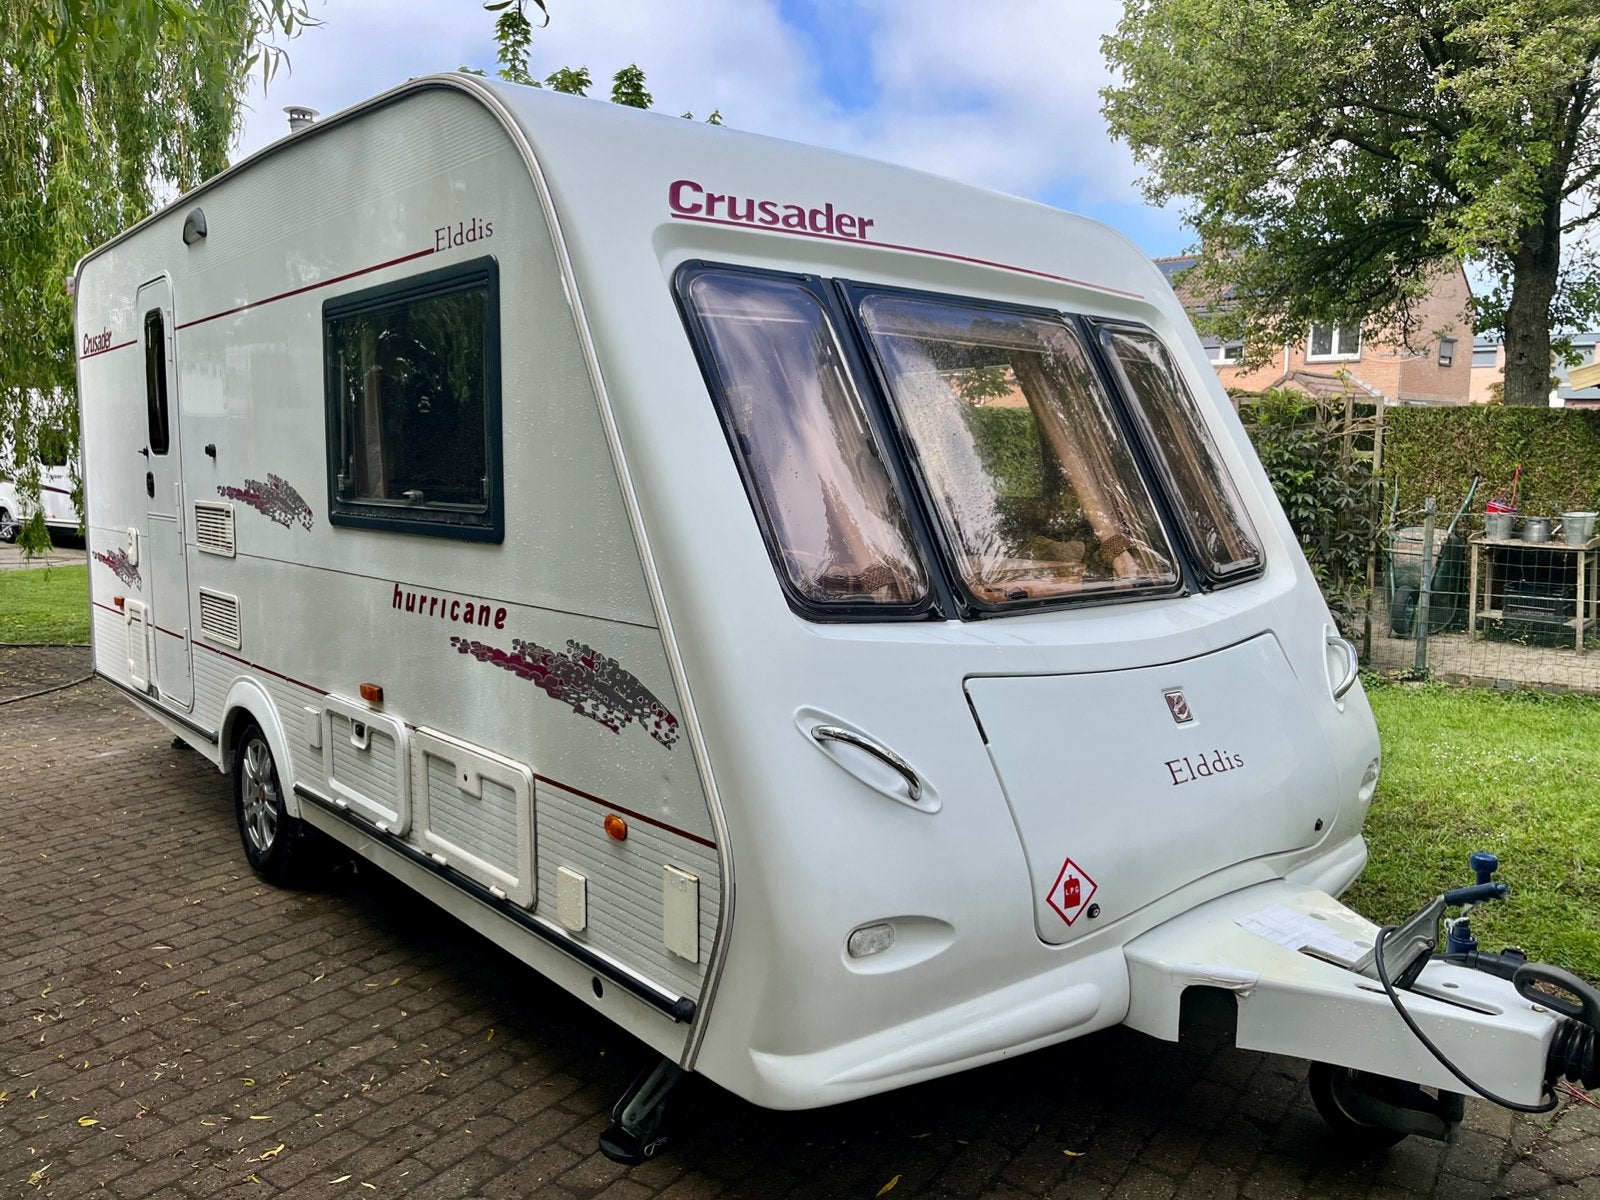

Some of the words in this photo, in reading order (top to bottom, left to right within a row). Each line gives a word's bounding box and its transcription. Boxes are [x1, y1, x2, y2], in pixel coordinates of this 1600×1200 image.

[669, 180, 874, 239] Crusader
[434, 218, 493, 252] Elddis
[83, 326, 112, 355] Crusader
[392, 583, 507, 629] hurricane
[1164, 750, 1244, 786] Elddis
[1065, 886, 1080, 896] LPG
